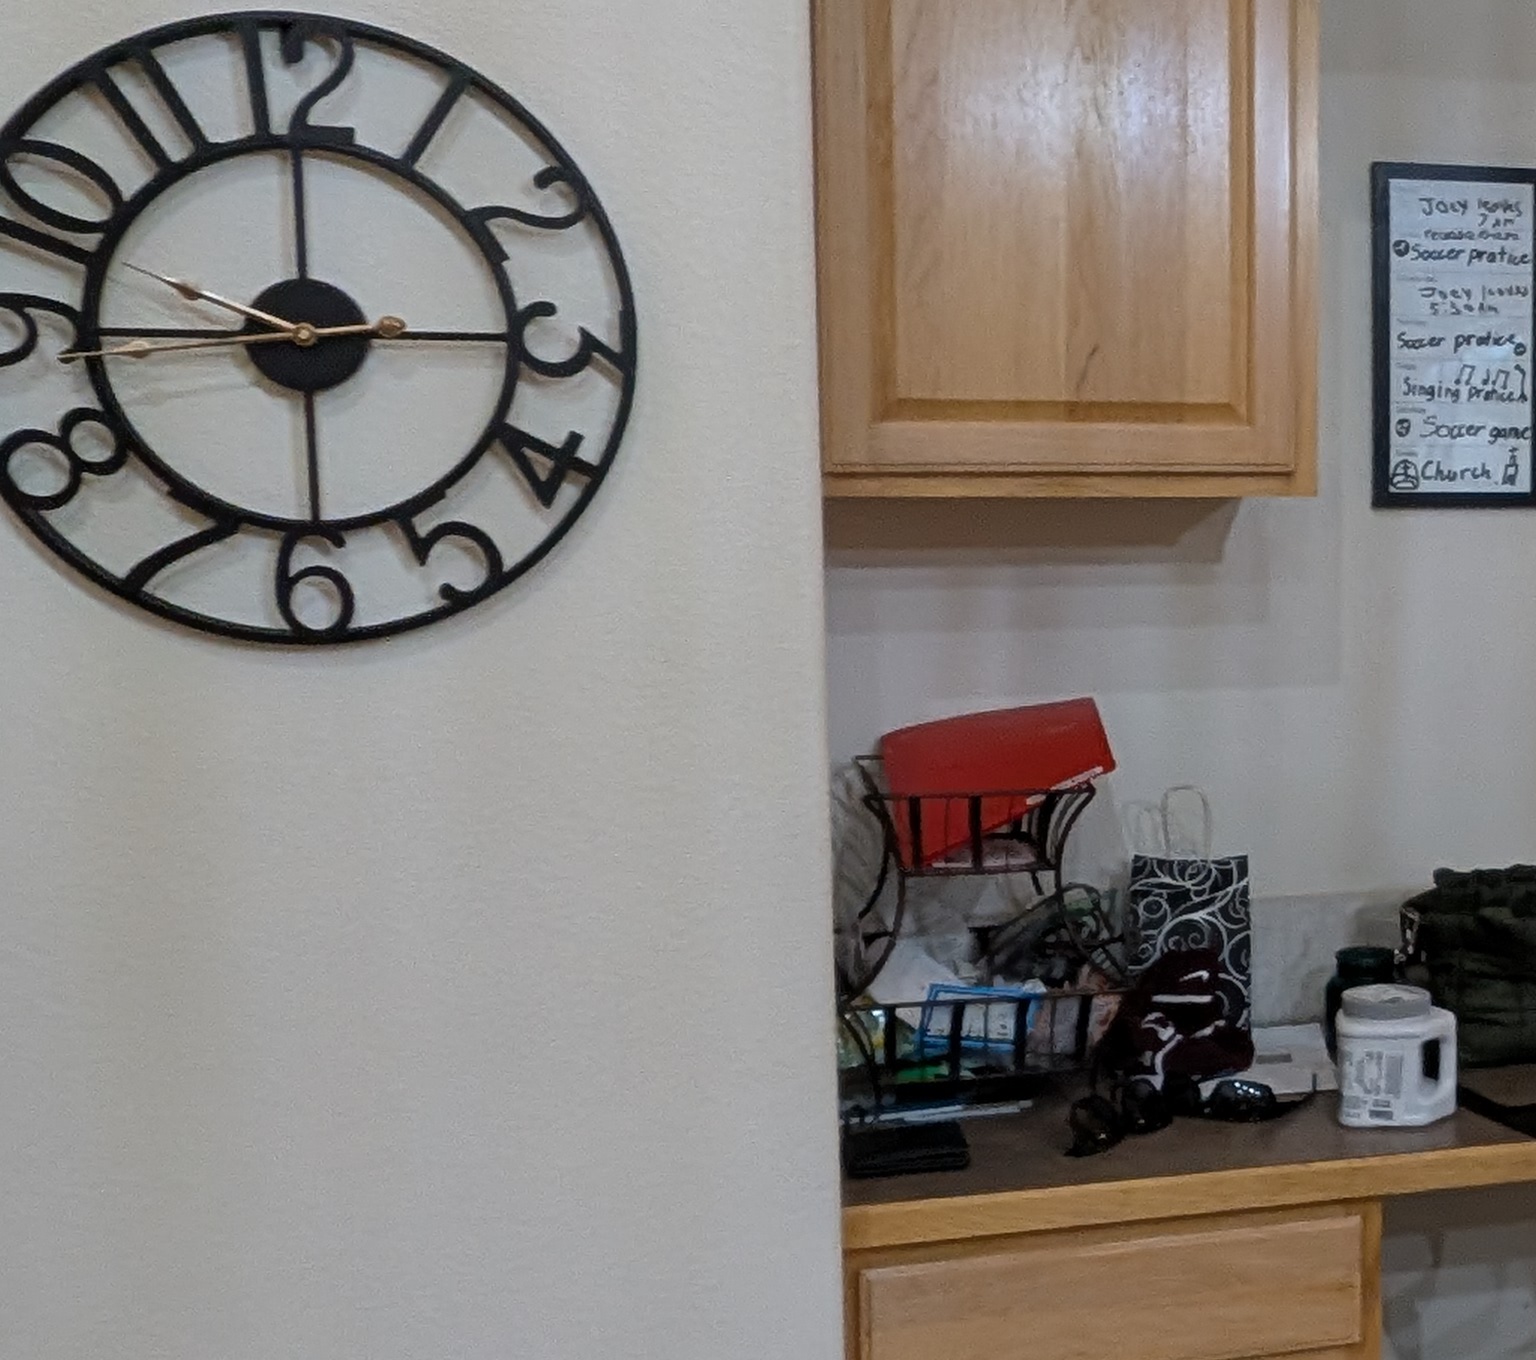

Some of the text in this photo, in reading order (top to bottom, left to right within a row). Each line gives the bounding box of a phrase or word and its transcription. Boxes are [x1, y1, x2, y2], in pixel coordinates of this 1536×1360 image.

[78, 43, 207, 172] 11
[240, 16, 355, 145] 12
[398, 65, 474, 173] 1
[0, 140, 128, 265] 10
[465, 165, 593, 266] 2
[513, 300, 637, 379] 3
[1402, 375, 1461, 404] Singing
[0, 406, 131, 512] 8
[497, 422, 602, 511] 4
[1419, 414, 1532, 446] Soccer game
[1420, 460, 1491, 482] Church
[275, 525, 356, 636] 6
[390, 497, 505, 607] 5
